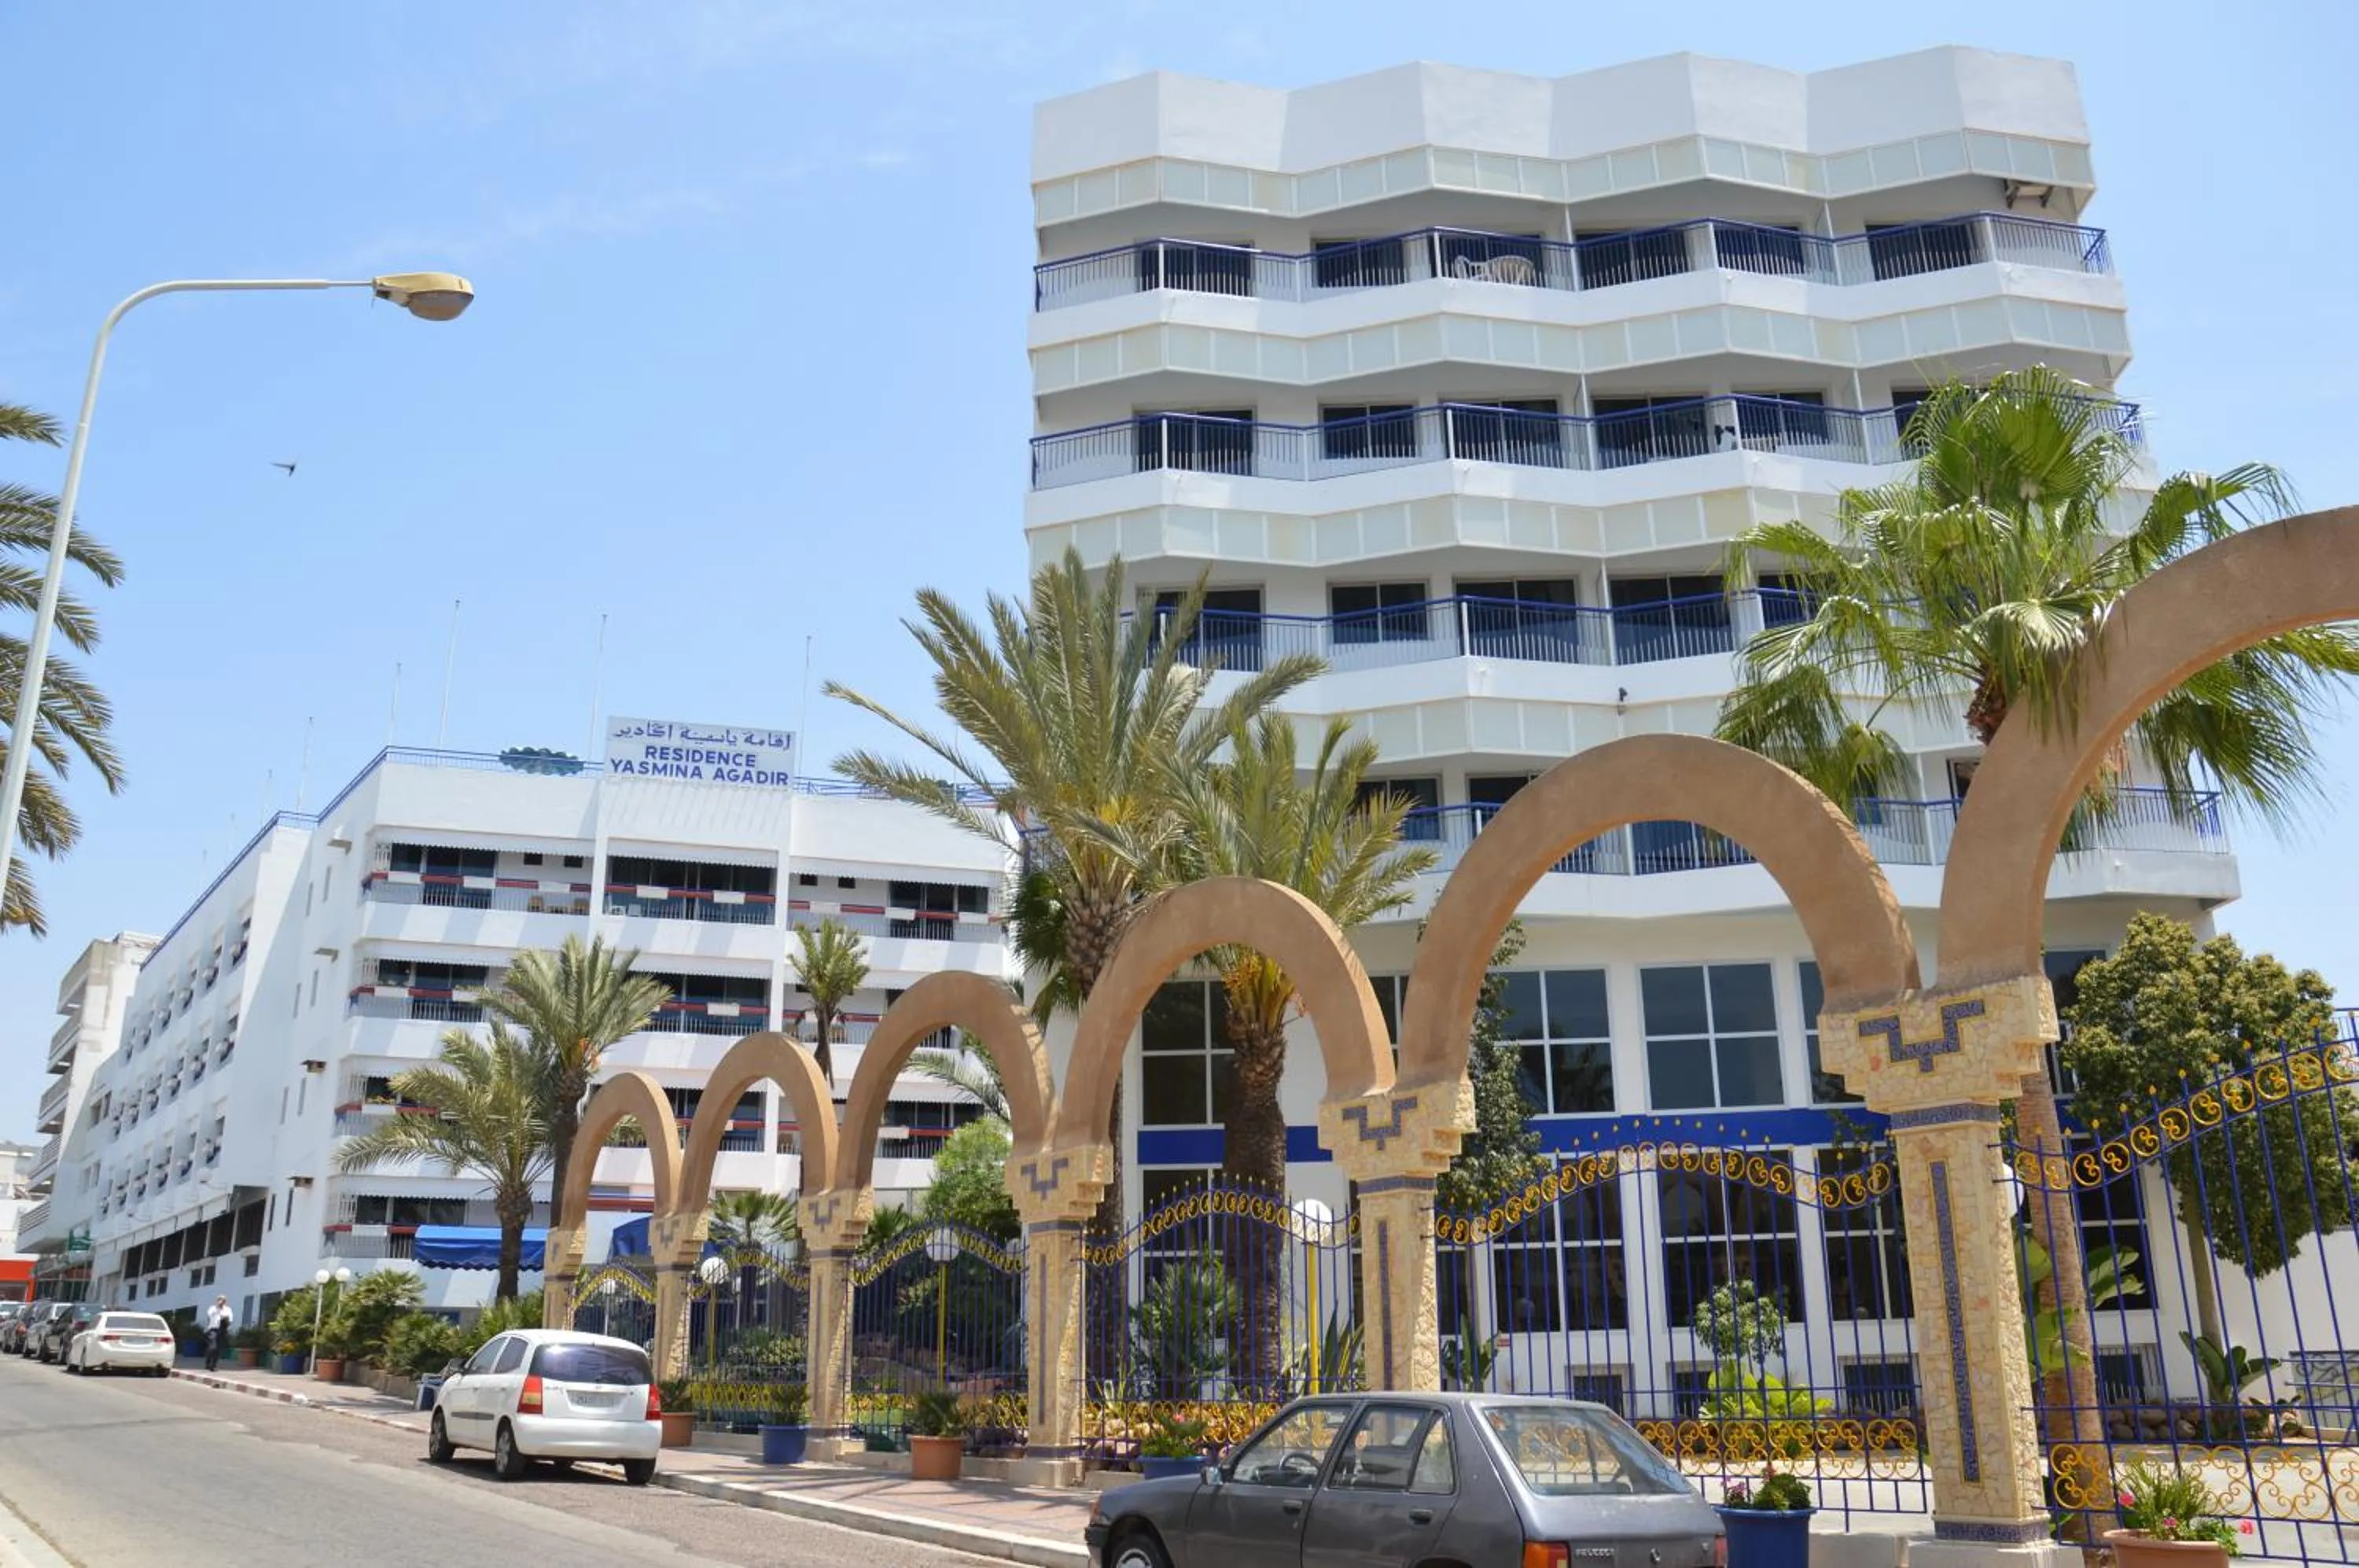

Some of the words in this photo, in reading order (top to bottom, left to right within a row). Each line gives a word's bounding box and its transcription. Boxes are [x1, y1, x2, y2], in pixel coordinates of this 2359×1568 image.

[645, 745, 756, 767] RESIDENCE
[610, 758, 703, 779] YASMINA
[712, 767, 789, 786] AGADIR
